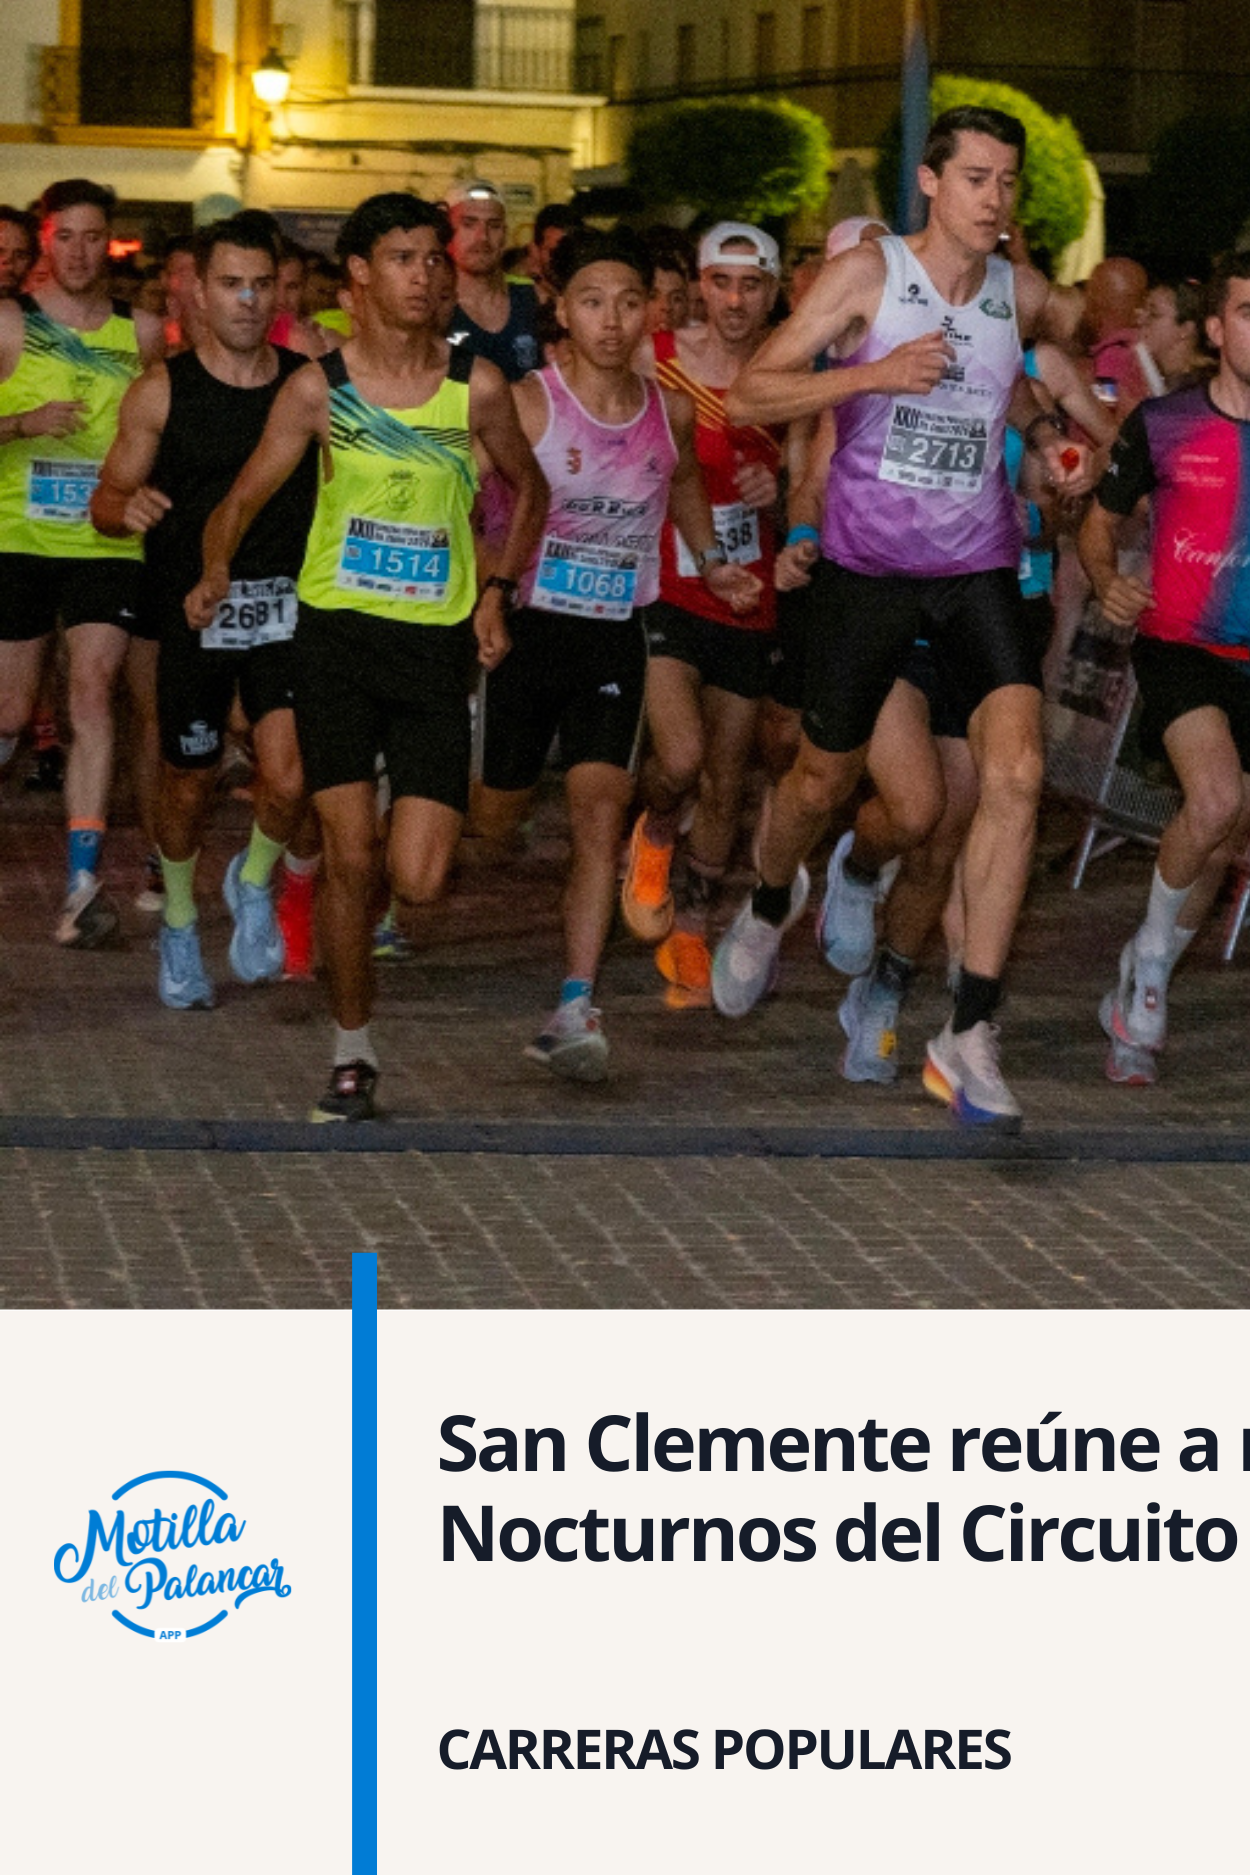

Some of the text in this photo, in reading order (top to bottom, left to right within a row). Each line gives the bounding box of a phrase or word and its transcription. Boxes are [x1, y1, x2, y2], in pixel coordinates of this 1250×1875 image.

[908, 437, 977, 469] 2713
[371, 547, 440, 578] 1514
[566, 568, 626, 598] 1068
[219, 599, 284, 629] 2681
